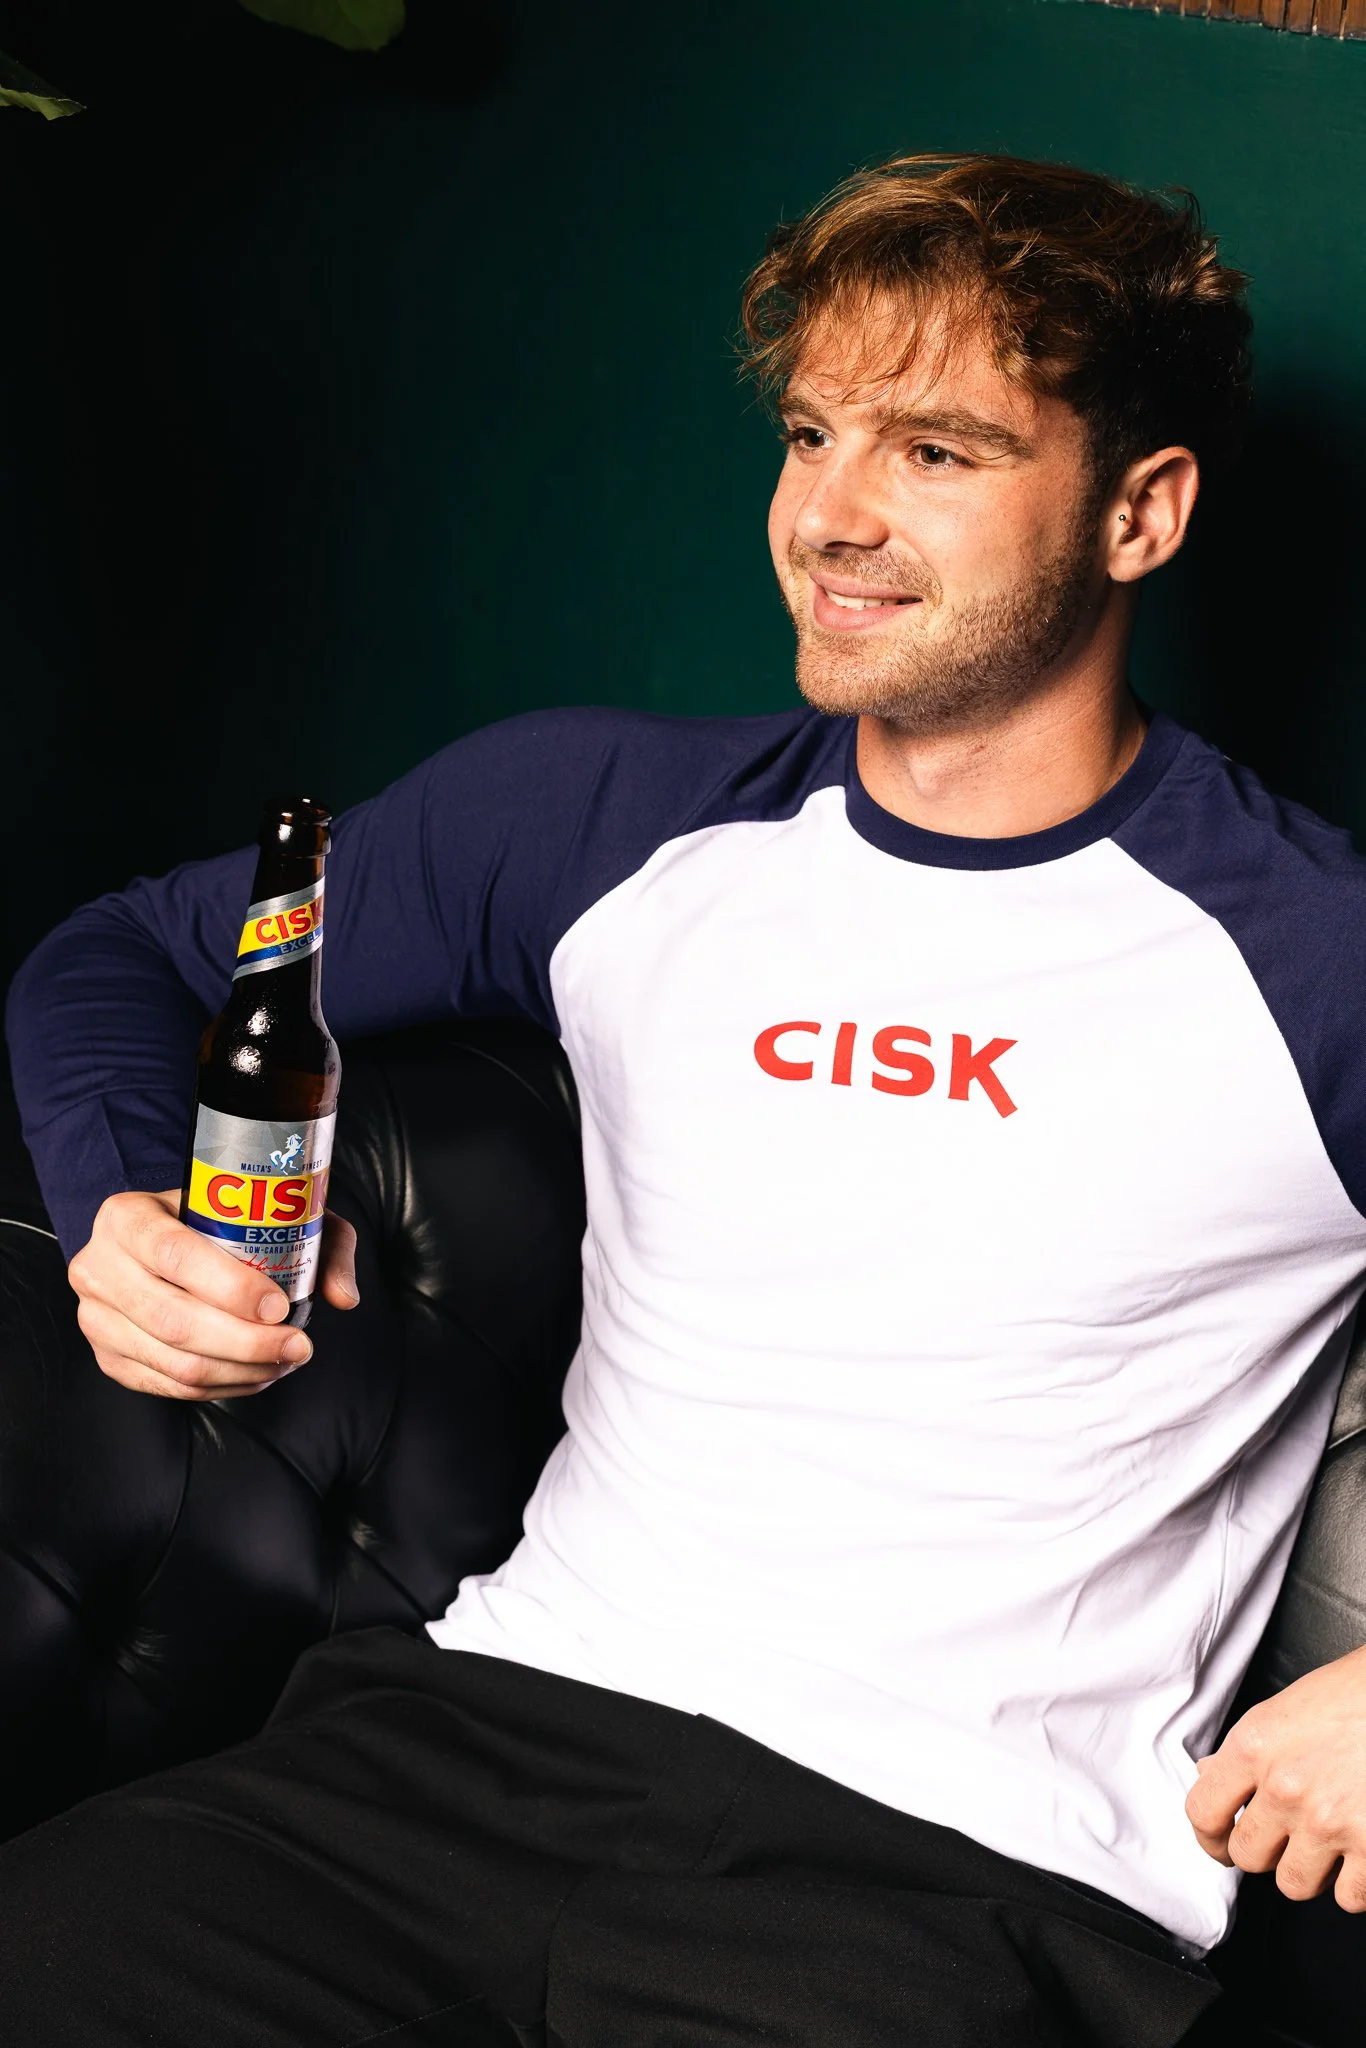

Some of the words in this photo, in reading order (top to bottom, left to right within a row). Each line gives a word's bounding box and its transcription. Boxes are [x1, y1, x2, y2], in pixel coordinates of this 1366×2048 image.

[280, 931, 319, 954] EXCEL
[754, 1021, 1017, 1117] CISK
[241, 1162, 272, 1173] MALTA'S
[302, 1160, 322, 1171] FINEST
[245, 1226, 307, 1242] EXCEL
[244, 1245, 284, 1254] LOW-CARB
[286, 1242, 306, 1254] LAGER
